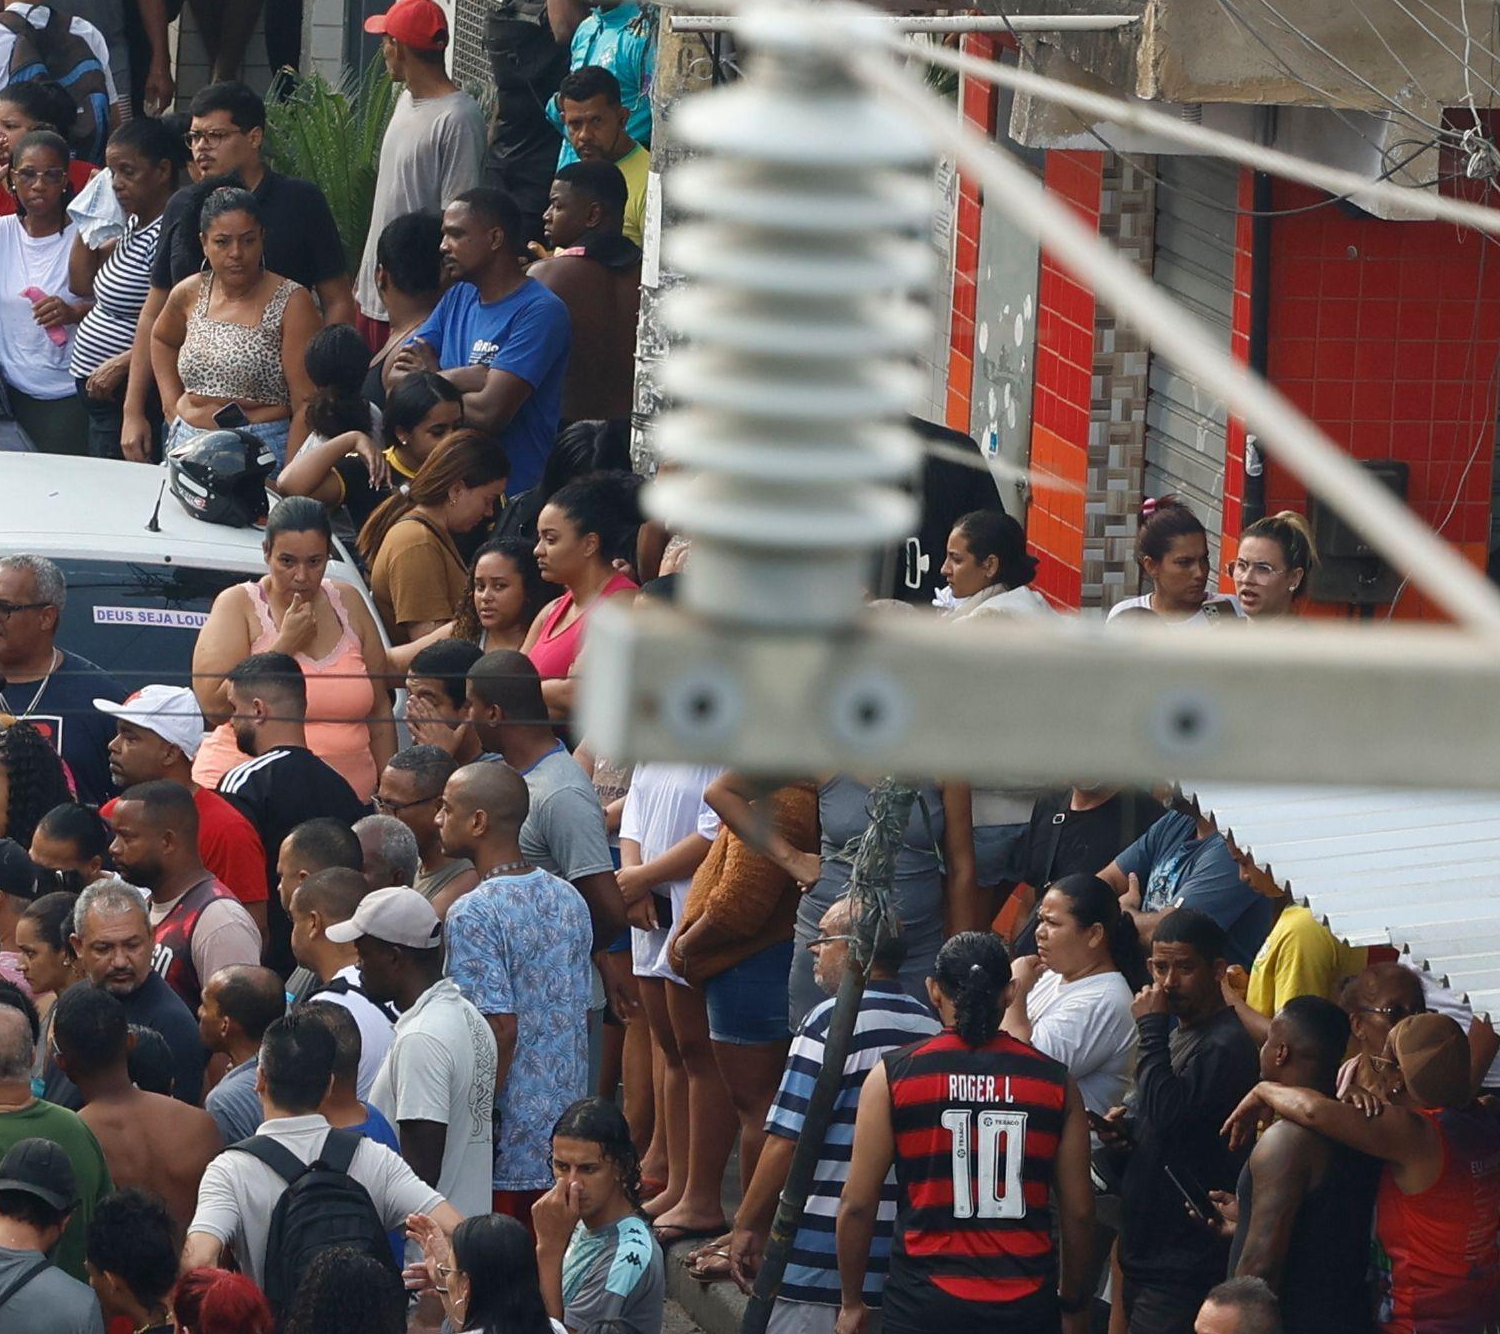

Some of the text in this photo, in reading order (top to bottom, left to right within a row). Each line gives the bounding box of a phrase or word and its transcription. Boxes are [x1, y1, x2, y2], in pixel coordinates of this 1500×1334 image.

[96, 609, 134, 623] DEUS
[137, 611, 173, 625] SEJA
[1005, 1075, 1014, 1104] L
[958, 1121, 966, 1147] TEXACO
[994, 1119, 1020, 1127] TEXACO
[941, 1108, 1029, 1219] 10
